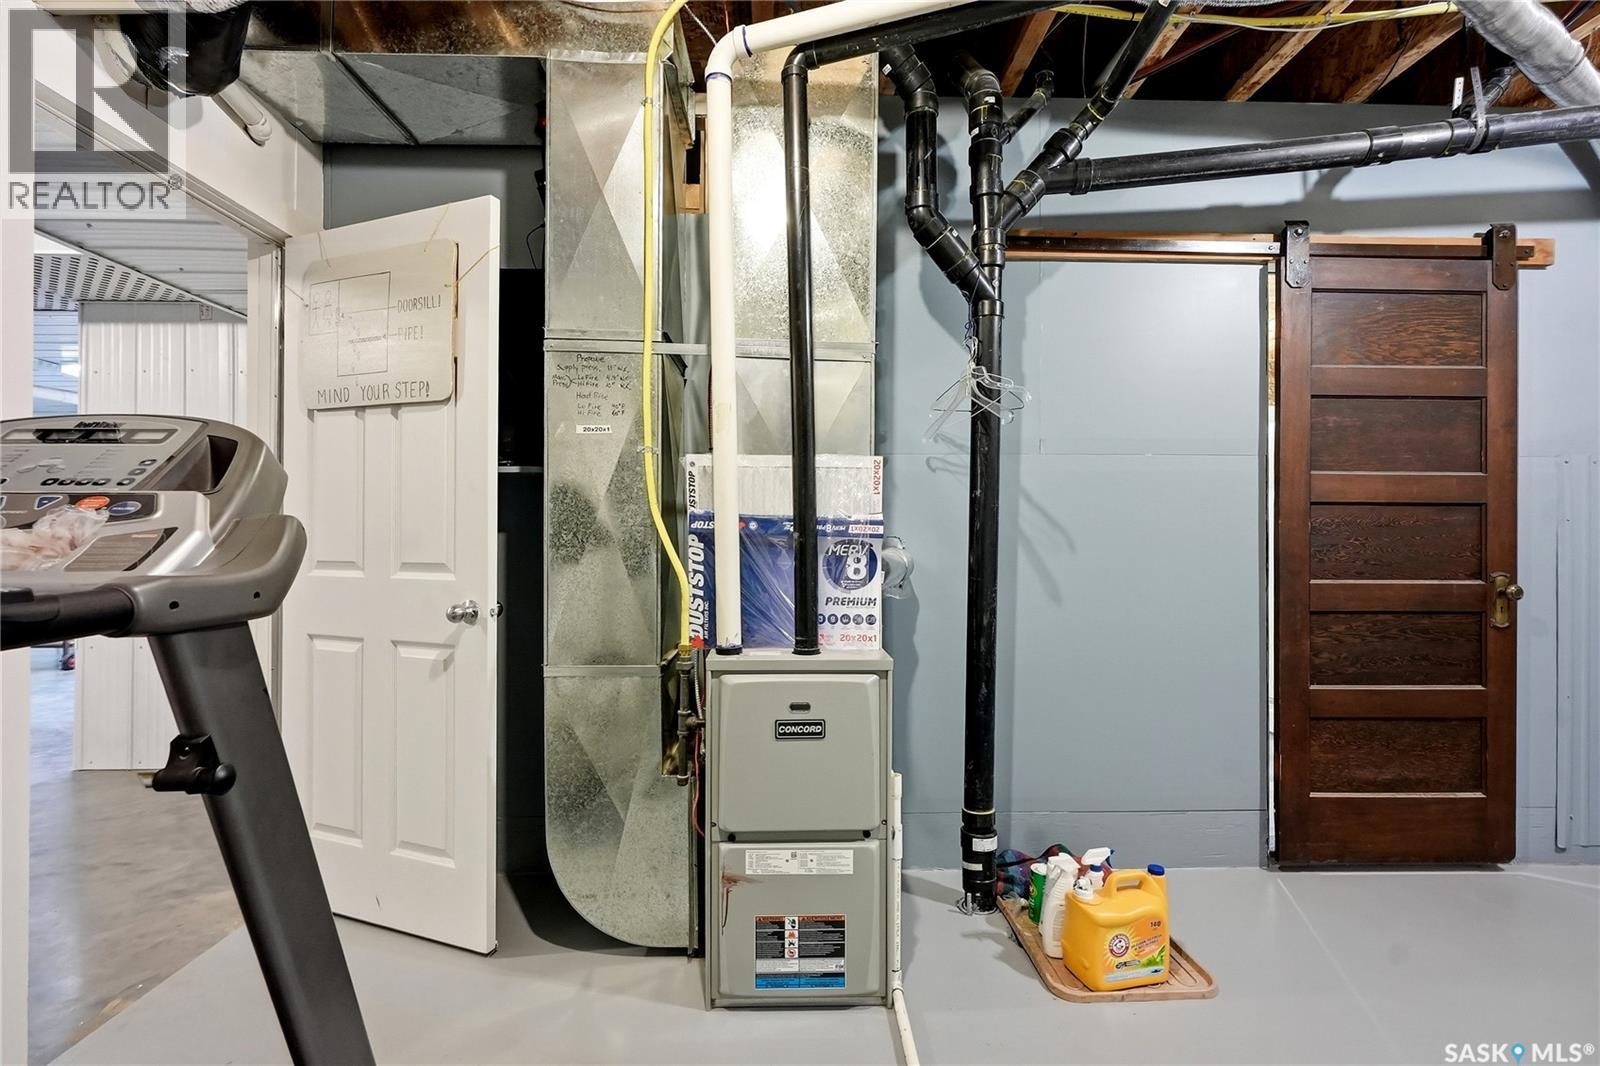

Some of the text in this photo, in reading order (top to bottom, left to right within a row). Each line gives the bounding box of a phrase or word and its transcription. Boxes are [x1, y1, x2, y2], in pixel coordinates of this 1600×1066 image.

[397, 294, 441, 312] DOORSILL!
[317, 380, 430, 404] MIND YOUR STEP!
[827, 544, 869, 556] MERV
[846, 553, 868, 581] 8
[688, 533, 705, 640] DUSTSTOP
[825, 597, 877, 607] PREMIUM
[840, 633, 877, 642] 20x20x1
[778, 725, 822, 733] CONCORD
